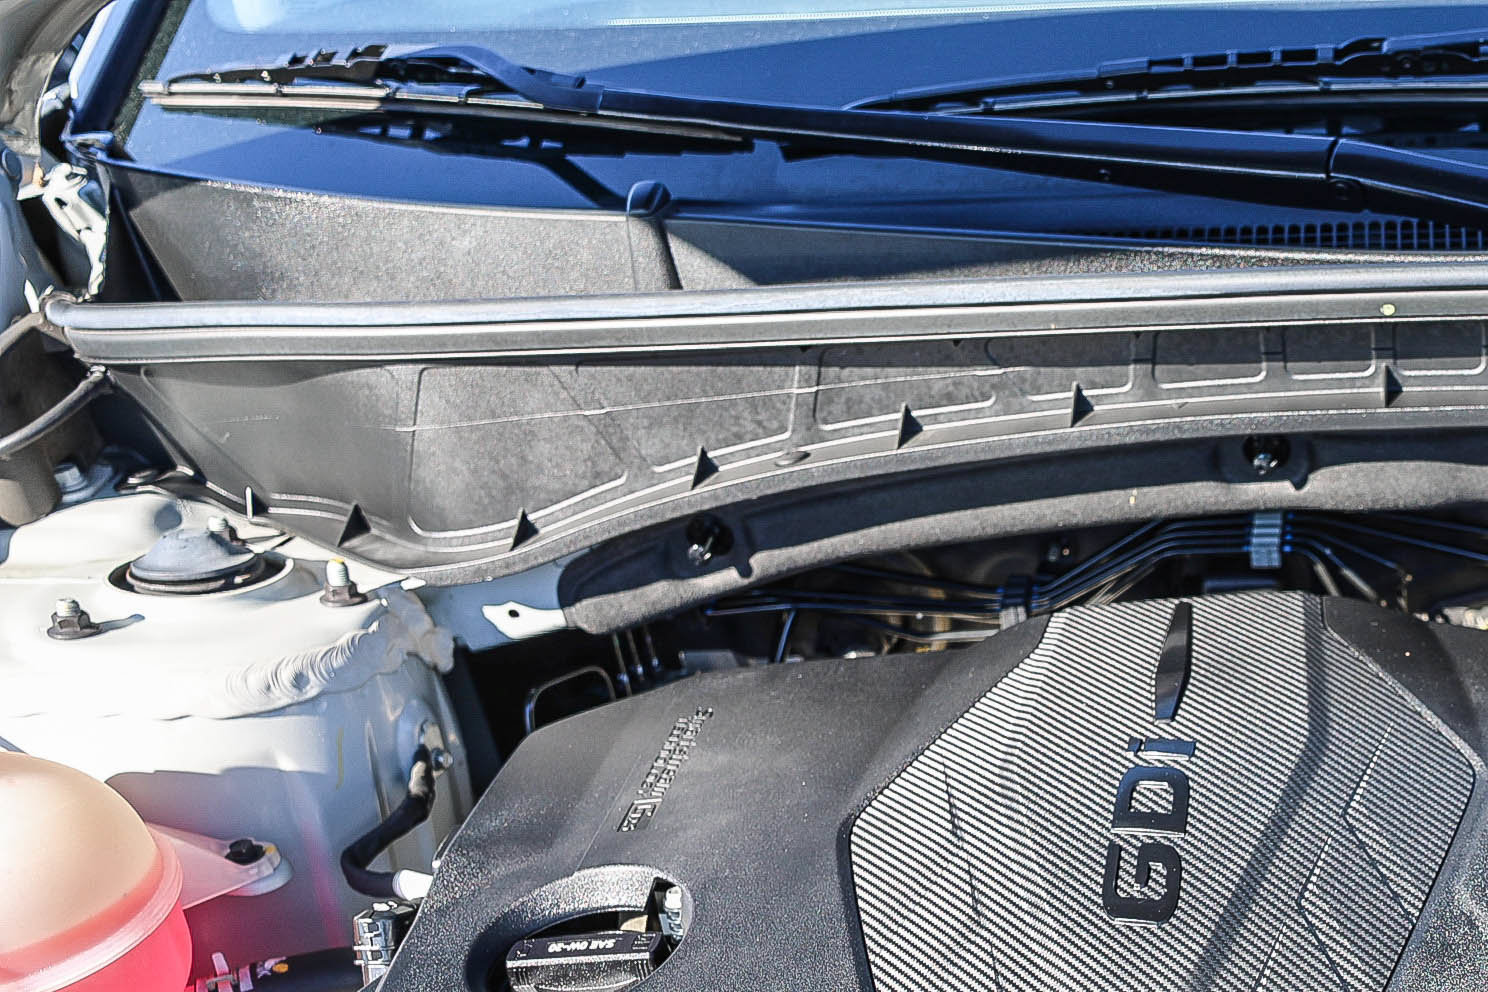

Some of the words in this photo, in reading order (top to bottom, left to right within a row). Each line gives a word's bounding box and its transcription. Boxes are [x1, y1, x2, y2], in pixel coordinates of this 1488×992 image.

[1102, 737, 1197, 925] GDi
[547, 941, 588, 953] 0W-20
[588, 938, 617, 950] SAE
